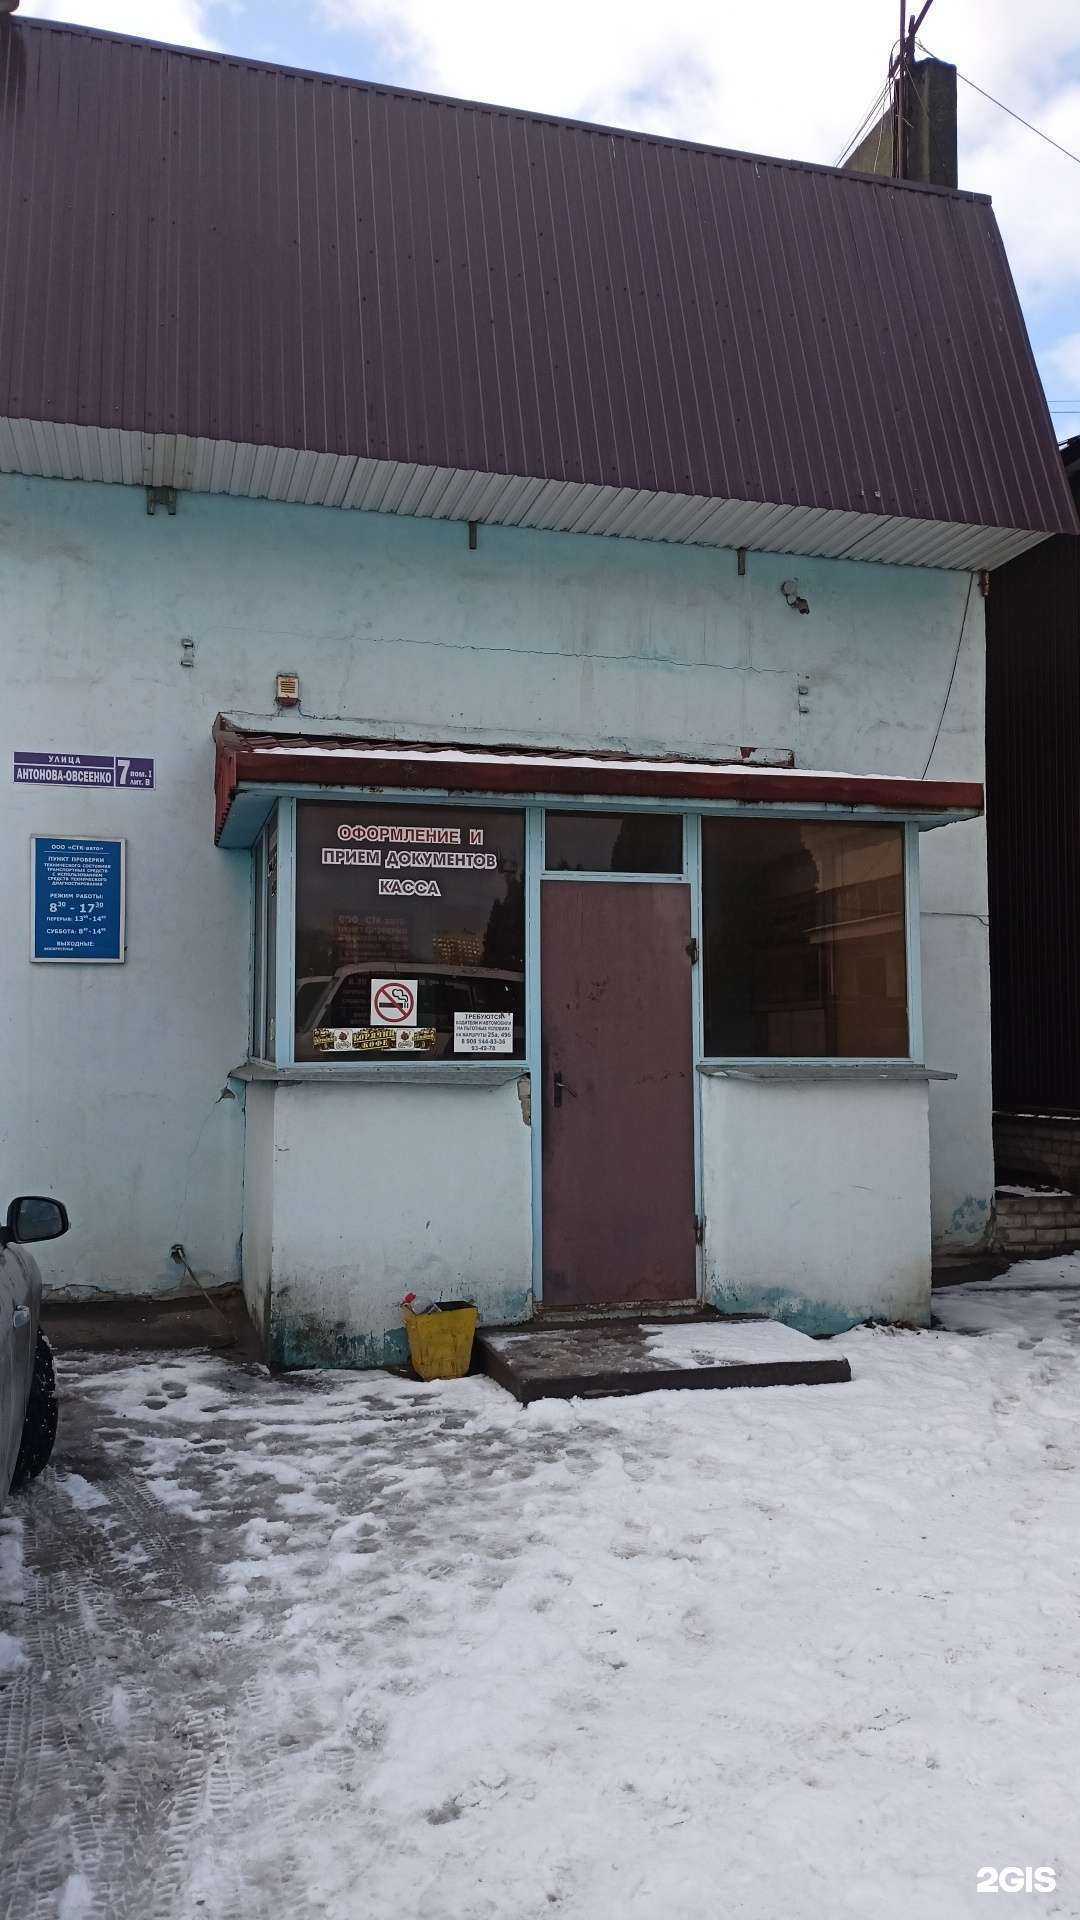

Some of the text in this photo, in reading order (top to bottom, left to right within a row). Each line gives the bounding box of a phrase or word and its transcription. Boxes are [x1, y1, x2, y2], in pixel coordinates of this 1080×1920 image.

[48, 755, 81, 765] УЛИЦА
[16, 767, 112, 784] АНТОНОВА-ОВСЕЕНКО
[117, 759, 131, 785] 7
[337, 825, 483, 845] ОФОРМЛЕНИЕ И
[321, 848, 498, 869] ПРИЕМ ДОКУМЕНТОВ
[378, 878, 441, 896] КАССА
